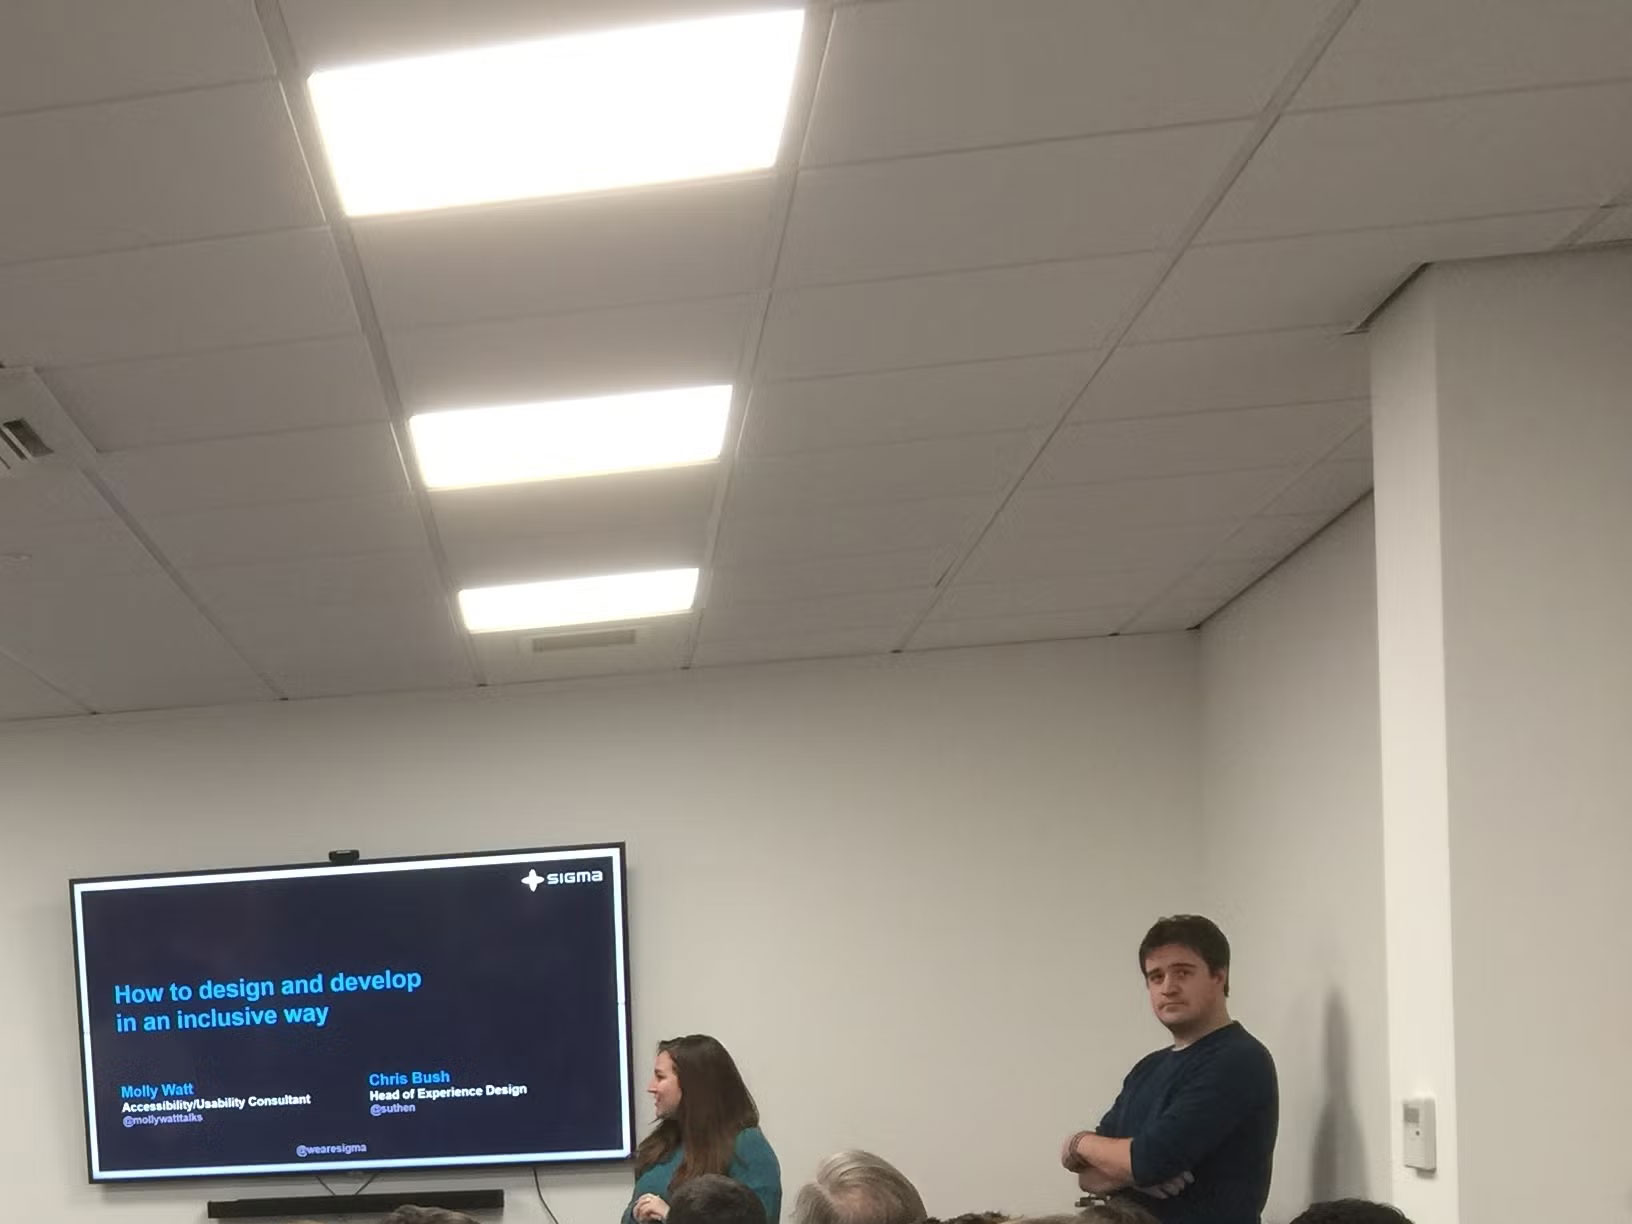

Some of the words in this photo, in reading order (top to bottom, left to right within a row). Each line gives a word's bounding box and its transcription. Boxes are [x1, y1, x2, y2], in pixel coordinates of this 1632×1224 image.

[115, 985, 164, 1004] How
[169, 982, 192, 1001] to
[199, 978, 274, 1001] design
[281, 974, 324, 995] and
[330, 970, 422, 992] develop
[116, 1013, 137, 1032] in
[143, 1014, 170, 1031] an
[177, 1006, 277, 1029] inclusive
[284, 1005, 329, 1026] way
[369, 1072, 408, 1086] Chris
[412, 1070, 450, 1084] Bush
[121, 1085, 158, 1099] Molly
[161, 1083, 194, 1097] Watt
[369, 1089, 400, 1101] Head
[402, 1088, 416, 1100] of
[417, 1086, 483, 1100] Experience
[486, 1083, 528, 1097] Design
[122, 1097, 245, 1112] Accessibility/Usability
[248, 1094, 311, 1107] Consultant
[370, 1103, 416, 1117] @suthen
[296, 1143, 367, 1158] @wearesigma
